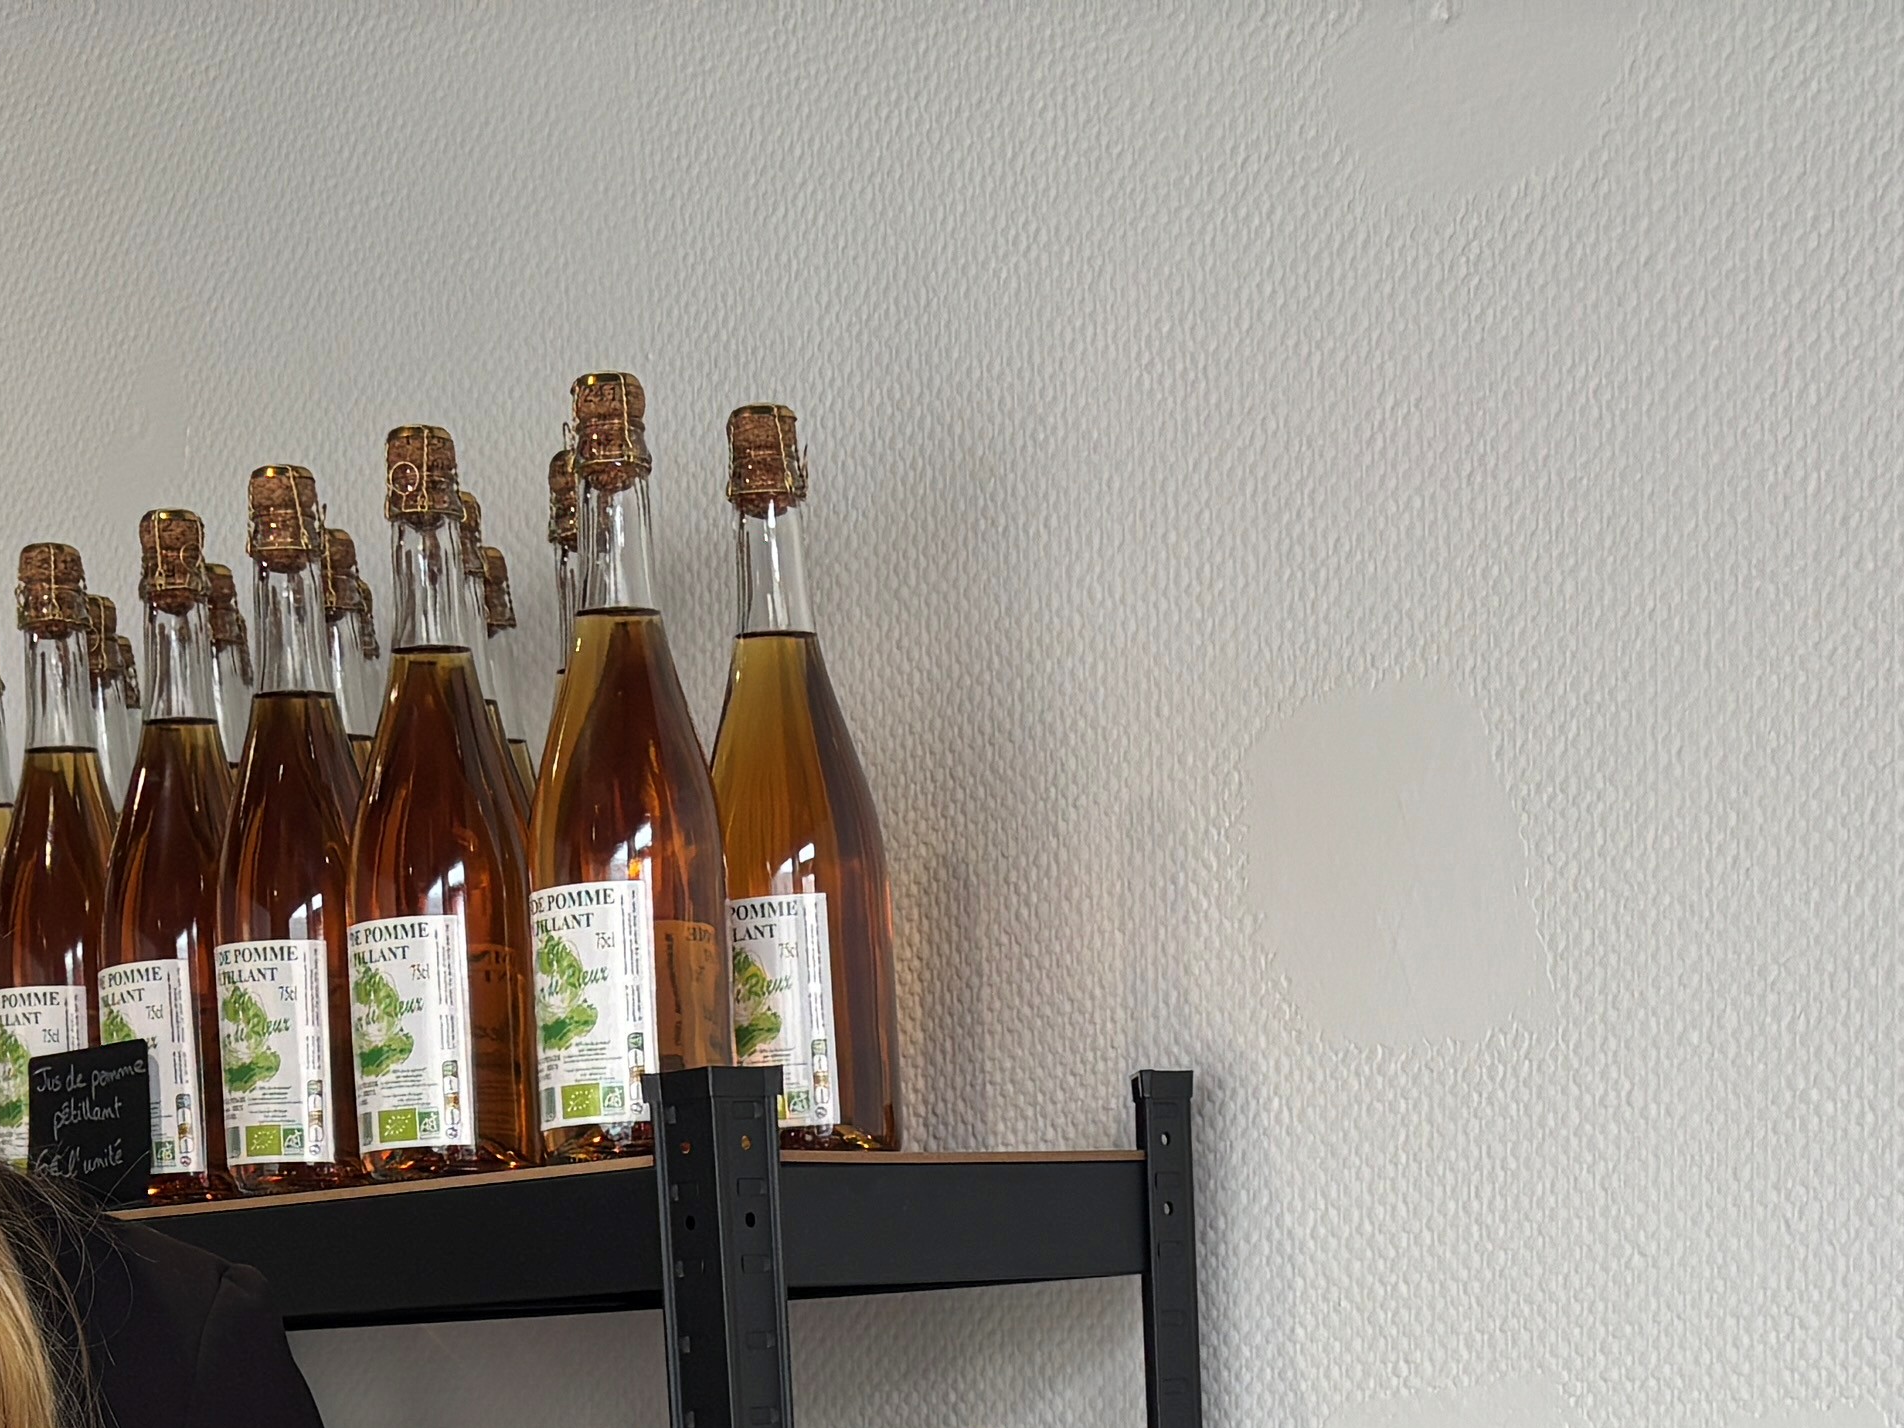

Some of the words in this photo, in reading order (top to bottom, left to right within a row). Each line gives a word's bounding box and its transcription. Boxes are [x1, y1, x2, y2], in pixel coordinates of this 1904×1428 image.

[547, 888, 615, 911] POMME
[365, 922, 429, 943] POMME
[234, 945, 298, 964] POMME
[108, 966, 163, 987] POMME
[2, 991, 60, 1009] POMME
[33, 1064, 62, 1092] Jus
[66, 1064, 87, 1092] de
[91, 1059, 146, 1100] pomme
